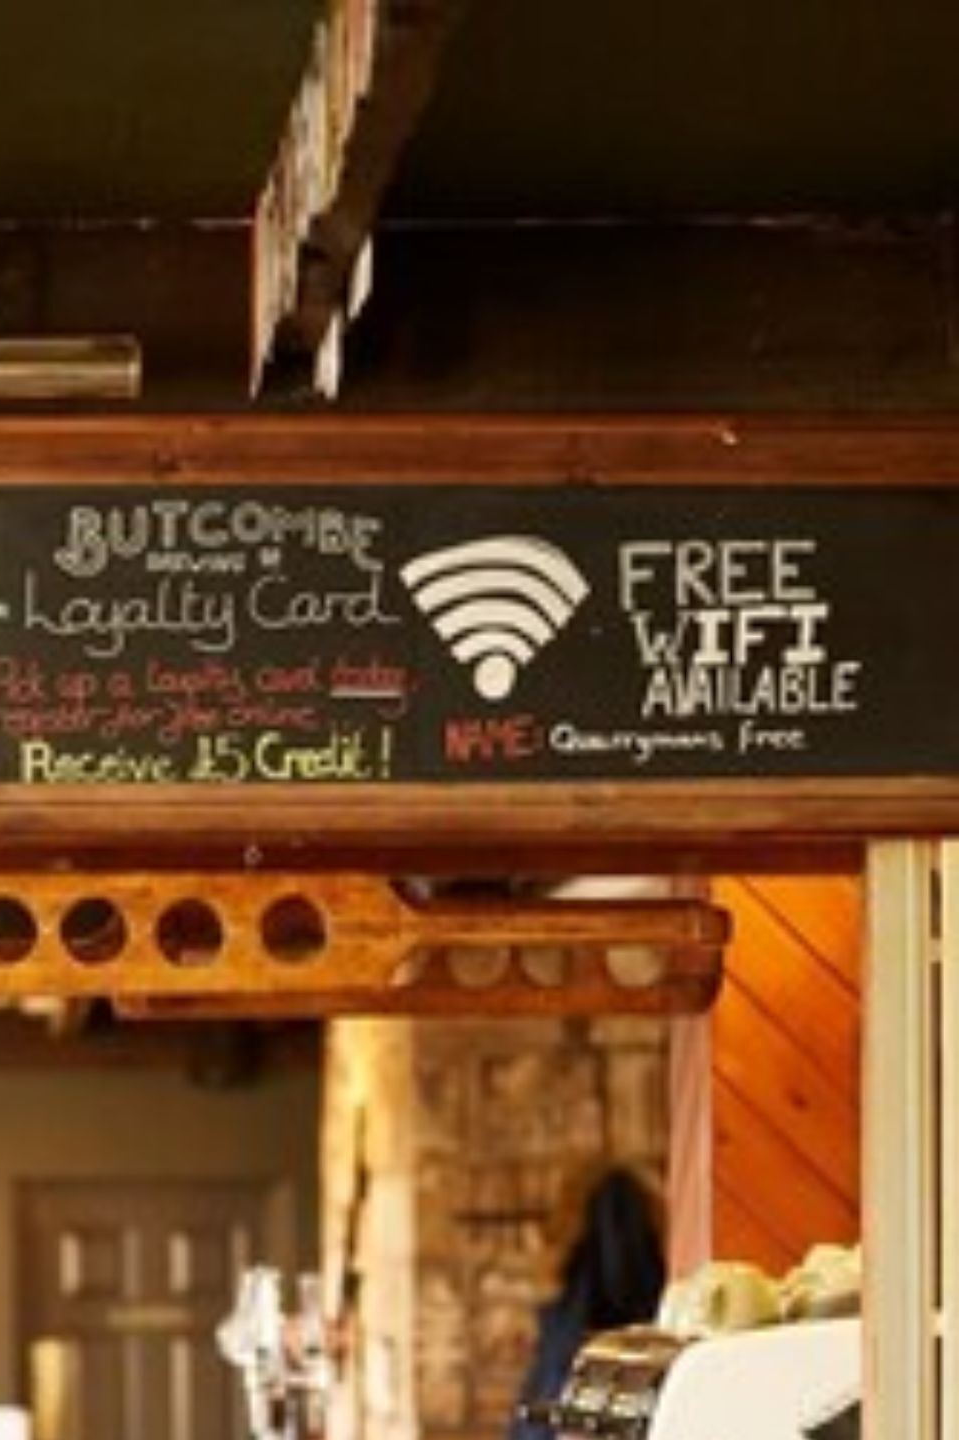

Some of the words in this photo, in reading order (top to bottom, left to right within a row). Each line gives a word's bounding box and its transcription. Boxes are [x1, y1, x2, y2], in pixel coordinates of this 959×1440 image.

[53, 501, 384, 577] BUTCOMBE
[618, 540, 817, 610] FREE
[24, 569, 236, 657] Loyalty
[249, 569, 401, 628] Card
[642, 661, 863, 719] AVAILABLE
[20, 738, 173, 784] Receive
